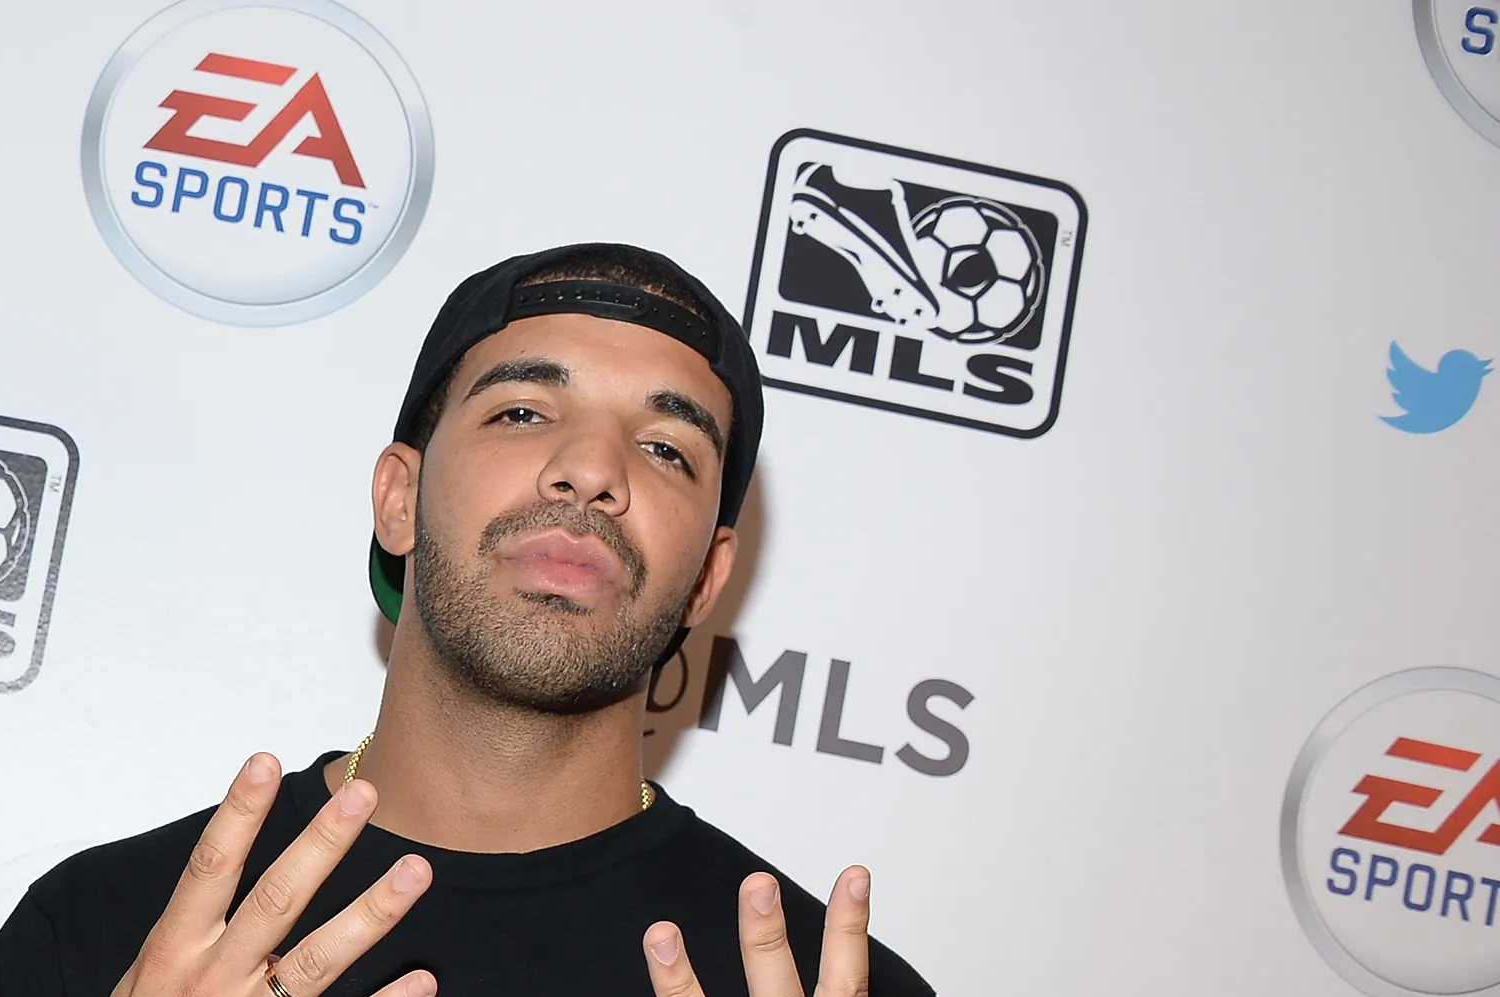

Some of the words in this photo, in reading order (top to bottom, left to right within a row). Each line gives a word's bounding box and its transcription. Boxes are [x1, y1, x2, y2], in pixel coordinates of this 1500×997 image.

[142, 53, 366, 188] EA
[130, 161, 367, 246] SPORTS
[765, 310, 1035, 406] MLS
[647, 634, 976, 777] MLS
